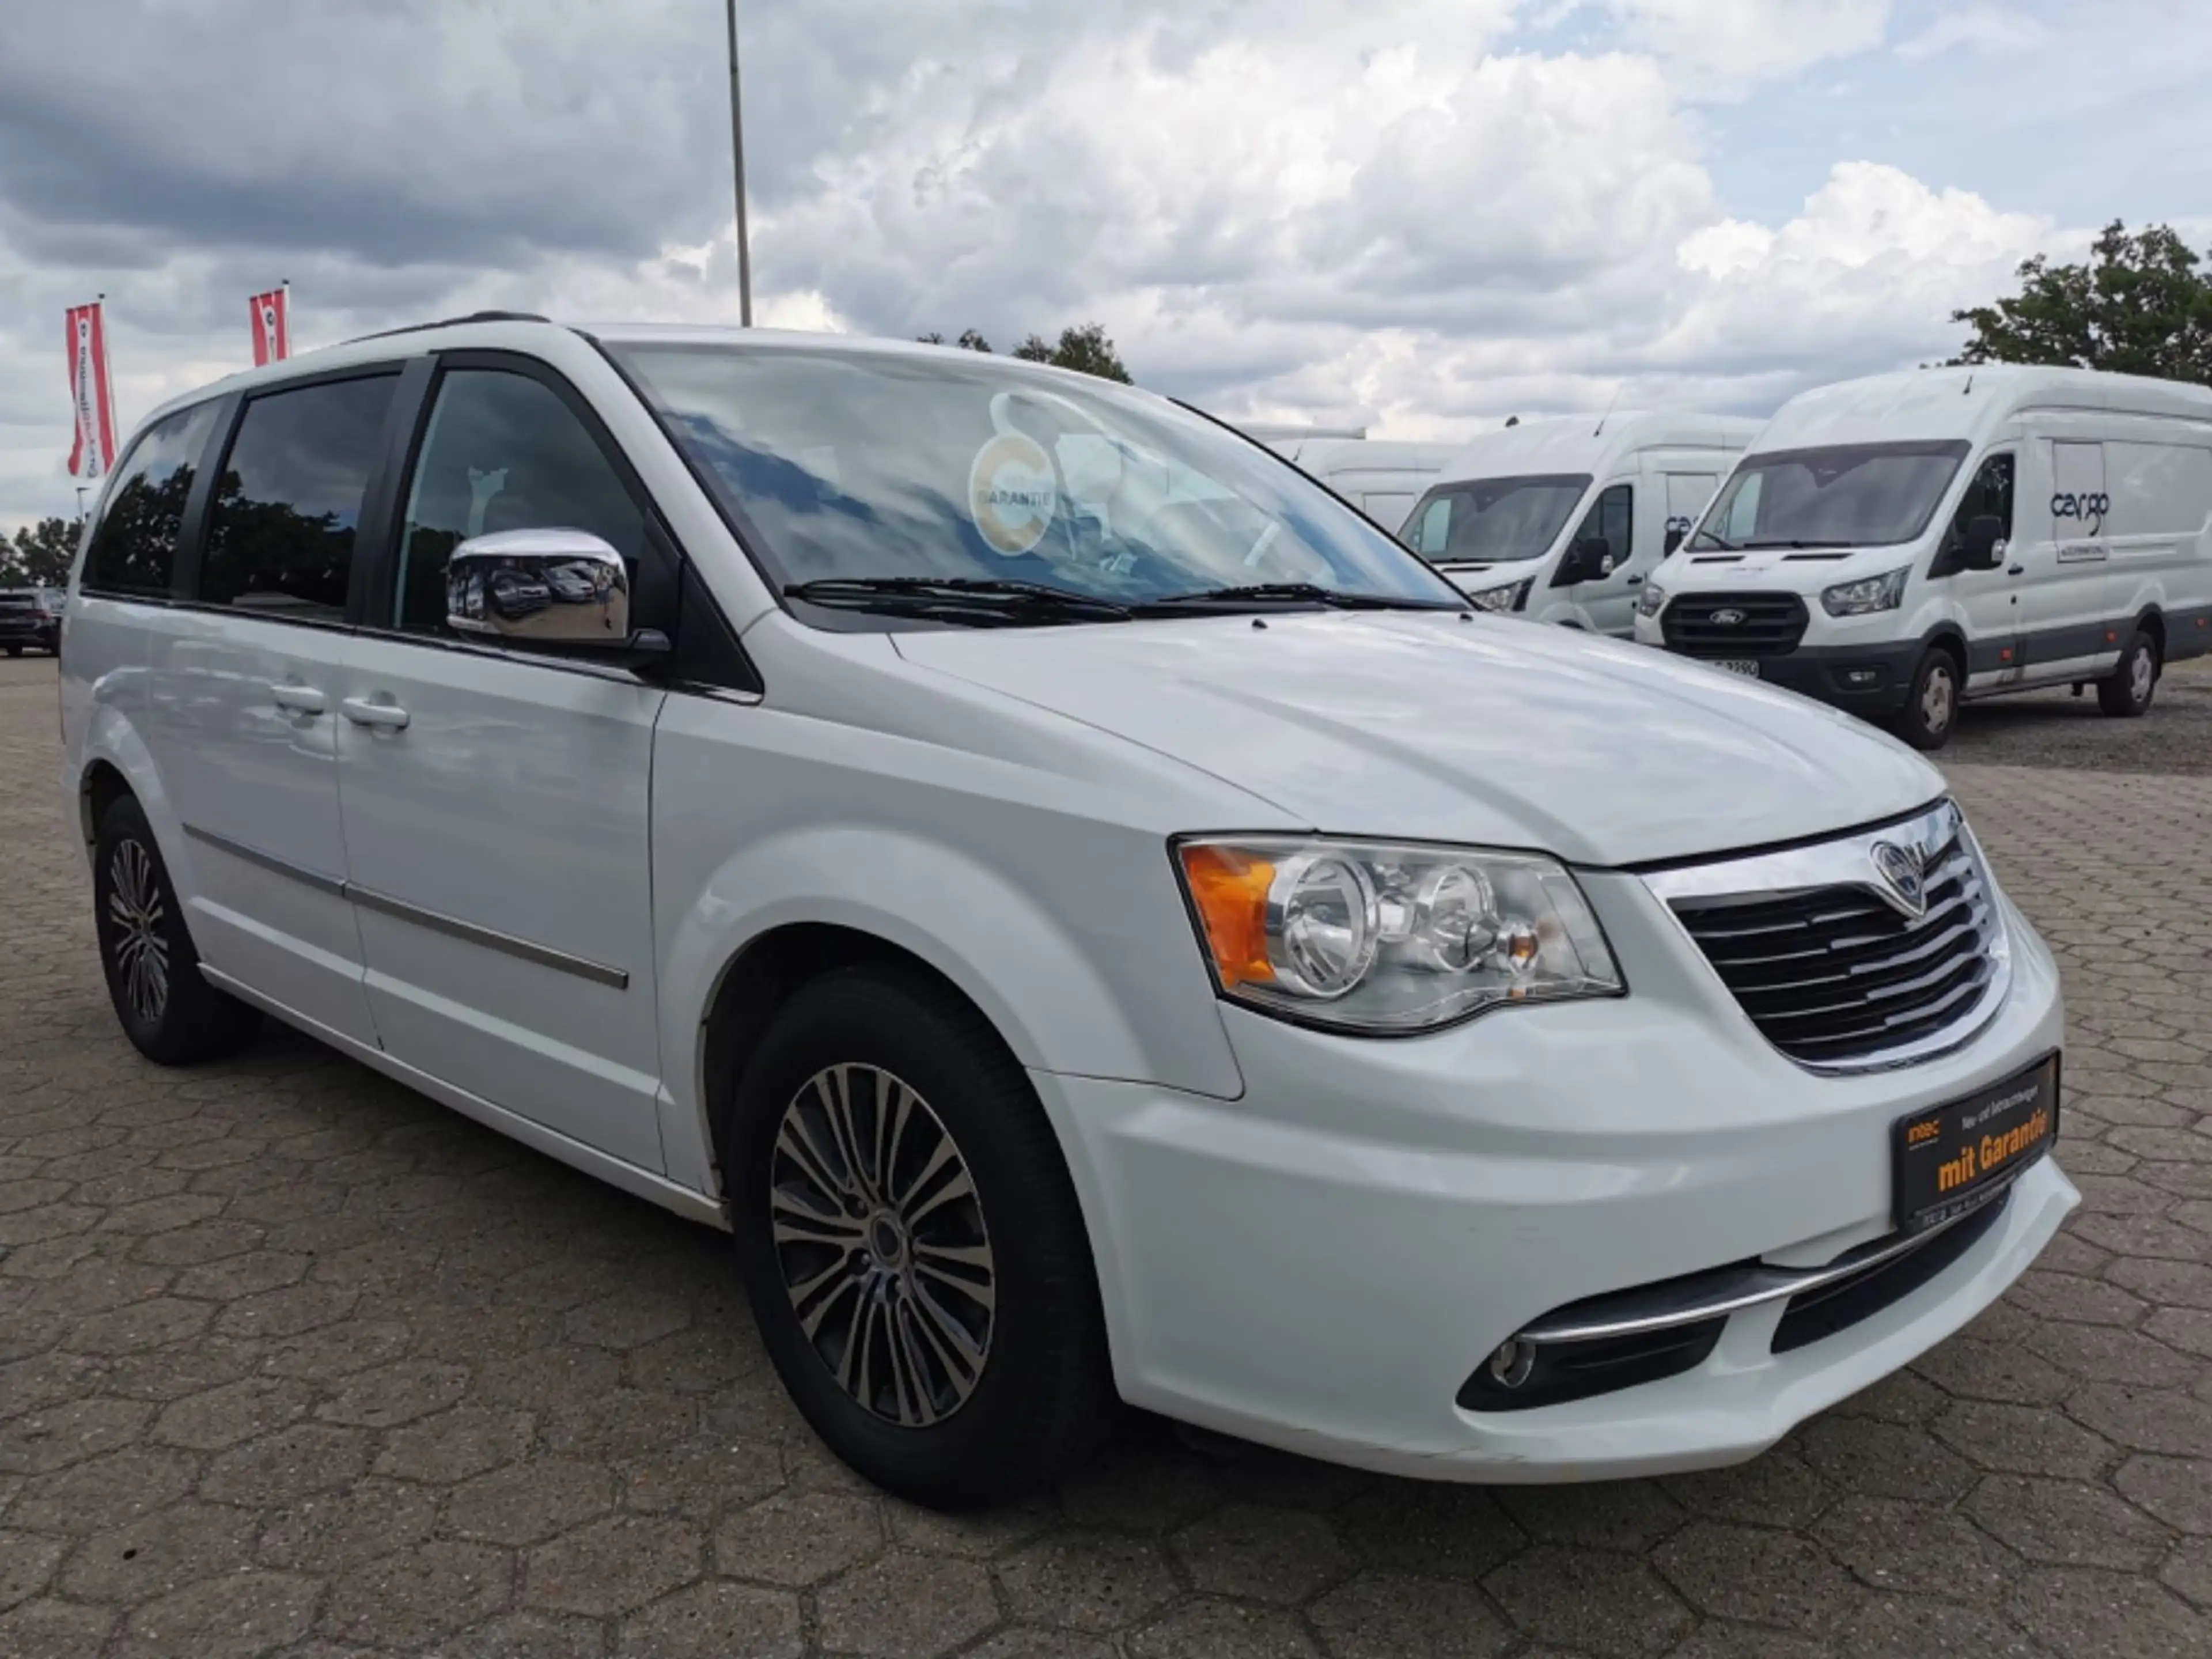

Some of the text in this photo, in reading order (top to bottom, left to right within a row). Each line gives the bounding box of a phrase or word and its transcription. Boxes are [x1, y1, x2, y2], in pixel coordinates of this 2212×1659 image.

[2051, 493, 2109, 537] cargo
[1938, 1107, 2047, 1192] mit Garantie
